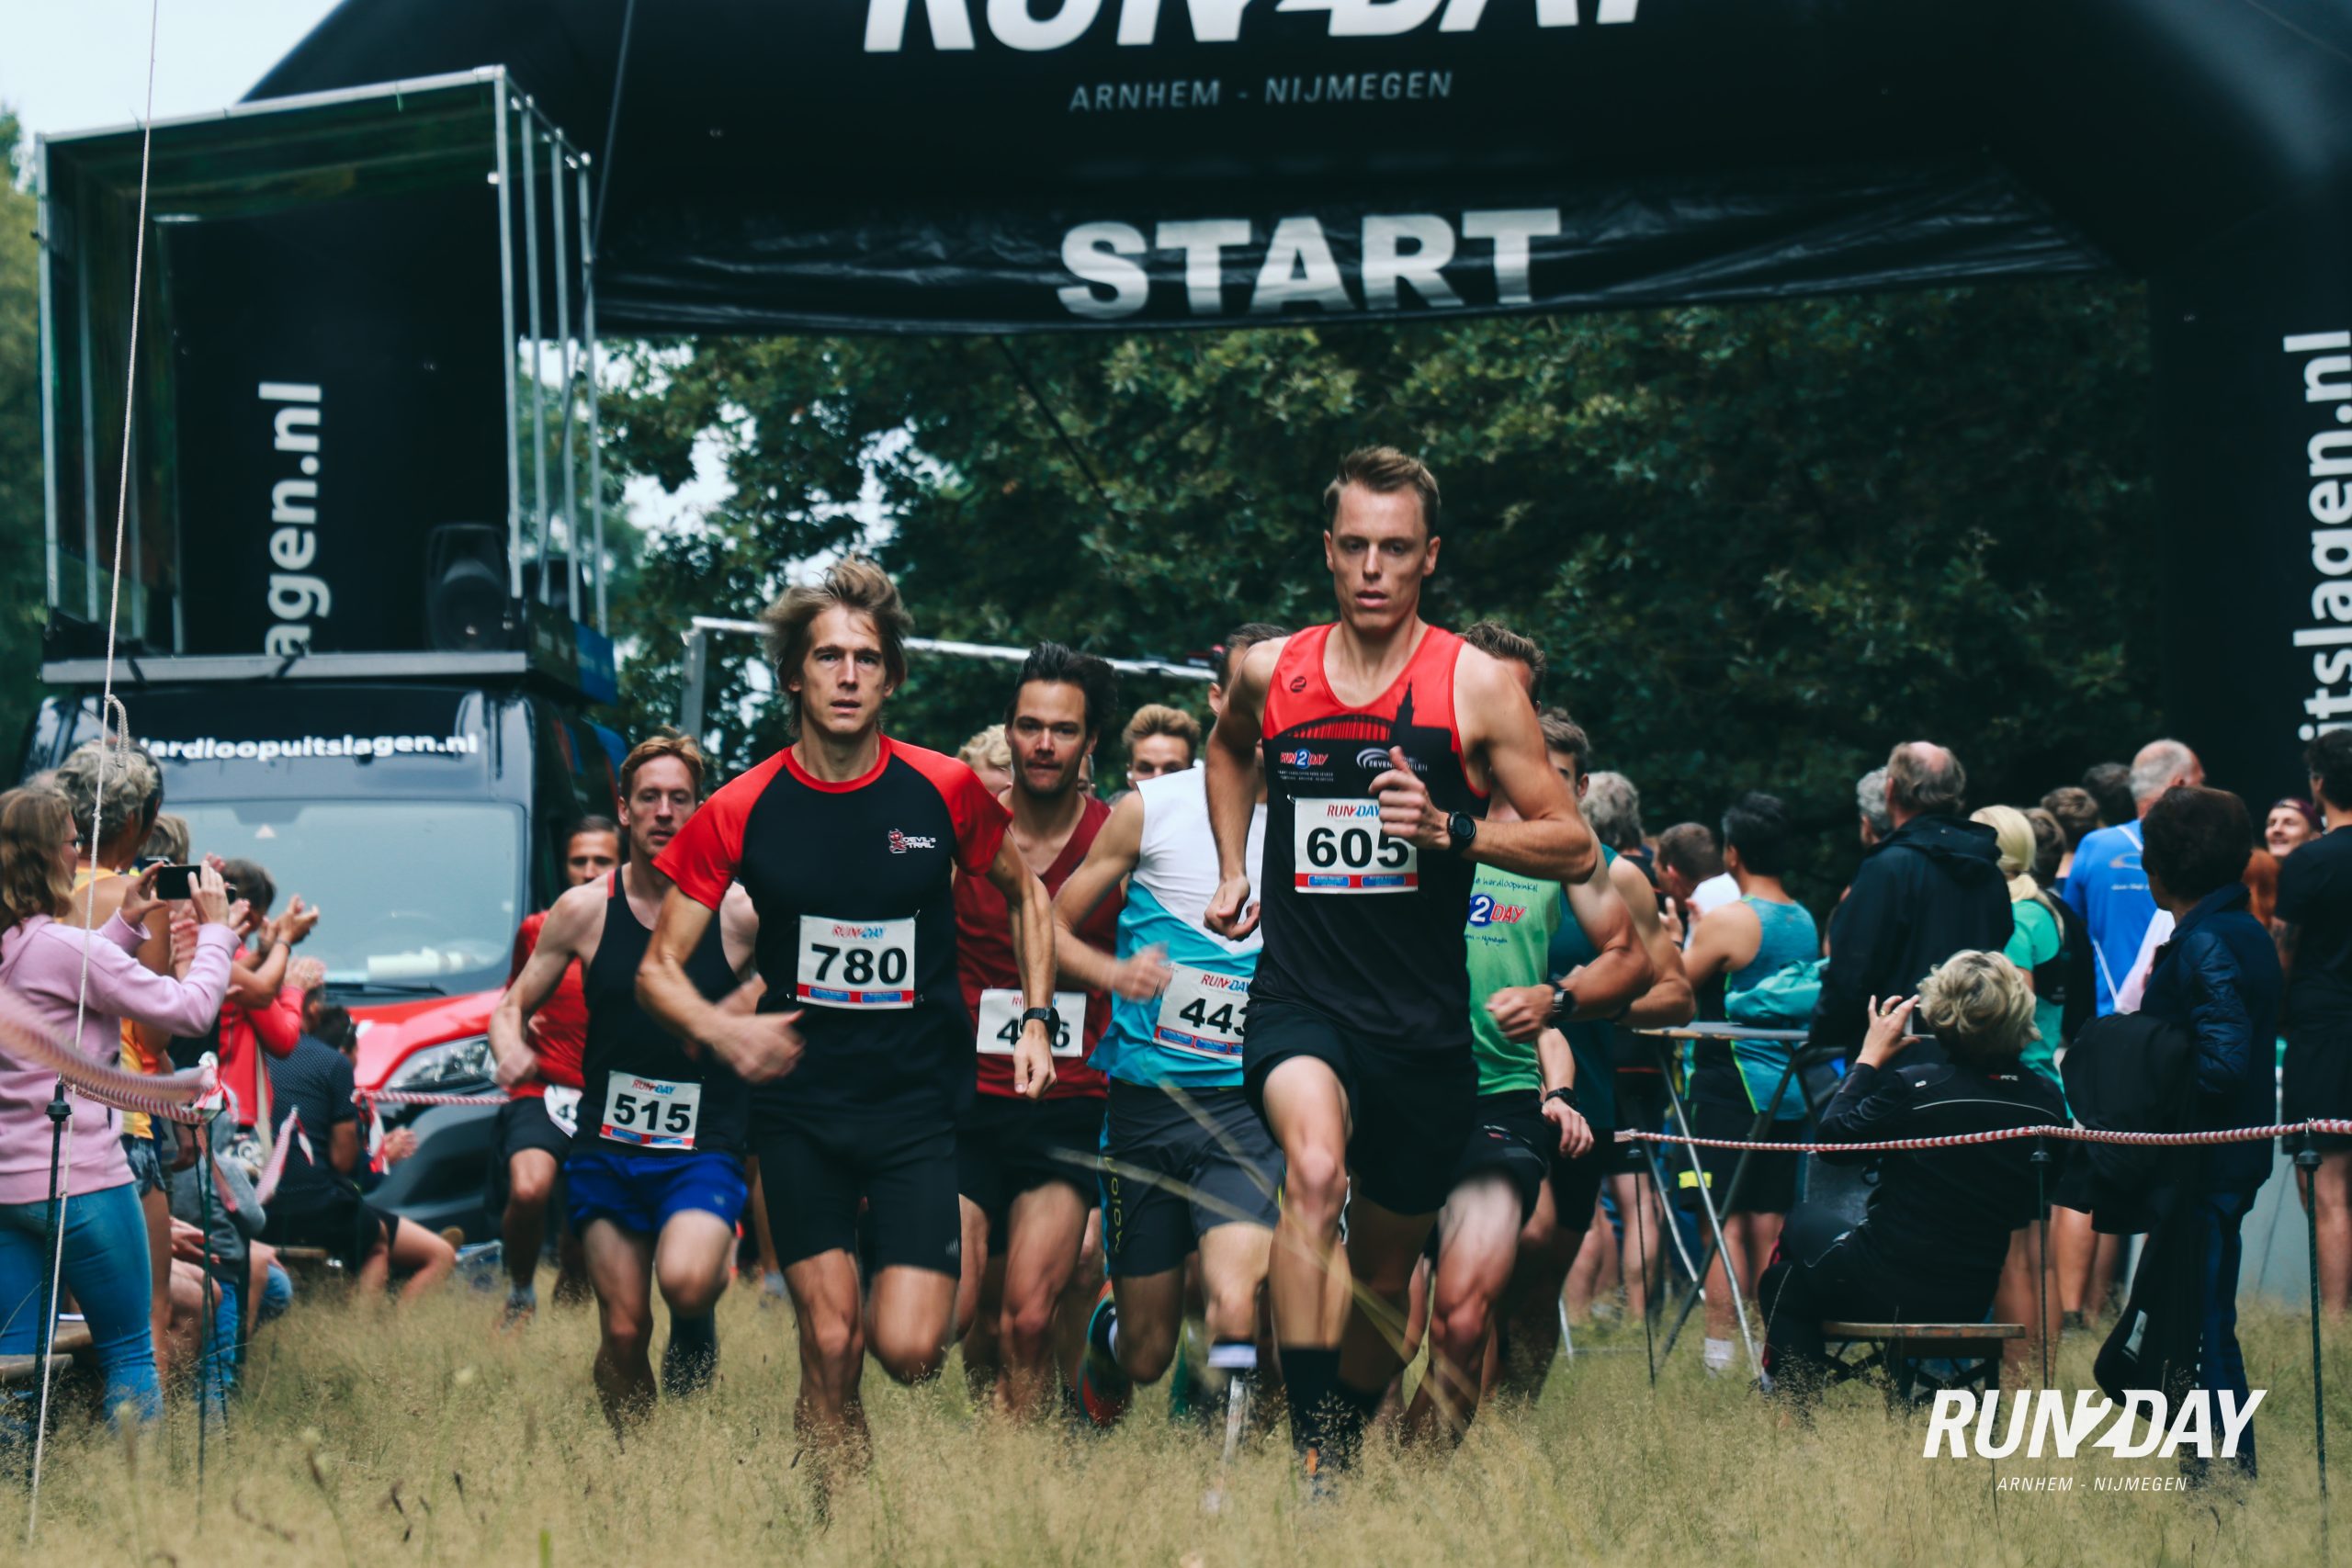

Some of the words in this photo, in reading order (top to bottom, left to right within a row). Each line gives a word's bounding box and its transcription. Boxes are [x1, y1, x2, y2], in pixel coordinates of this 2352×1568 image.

[1069, 80, 1220, 112] ARNHEM
[1265, 71, 1453, 106] NIJMEGEN
[1057, 208, 1561, 319] START
[1280, 750, 1329, 766] RUN2DAY
[1306, 827, 1408, 868] 605
[1470, 897, 1525, 924] 2DAY
[811, 942, 907, 986] 780
[997, 1017, 1070, 1048] 46
[614, 1093, 691, 1134] 515
